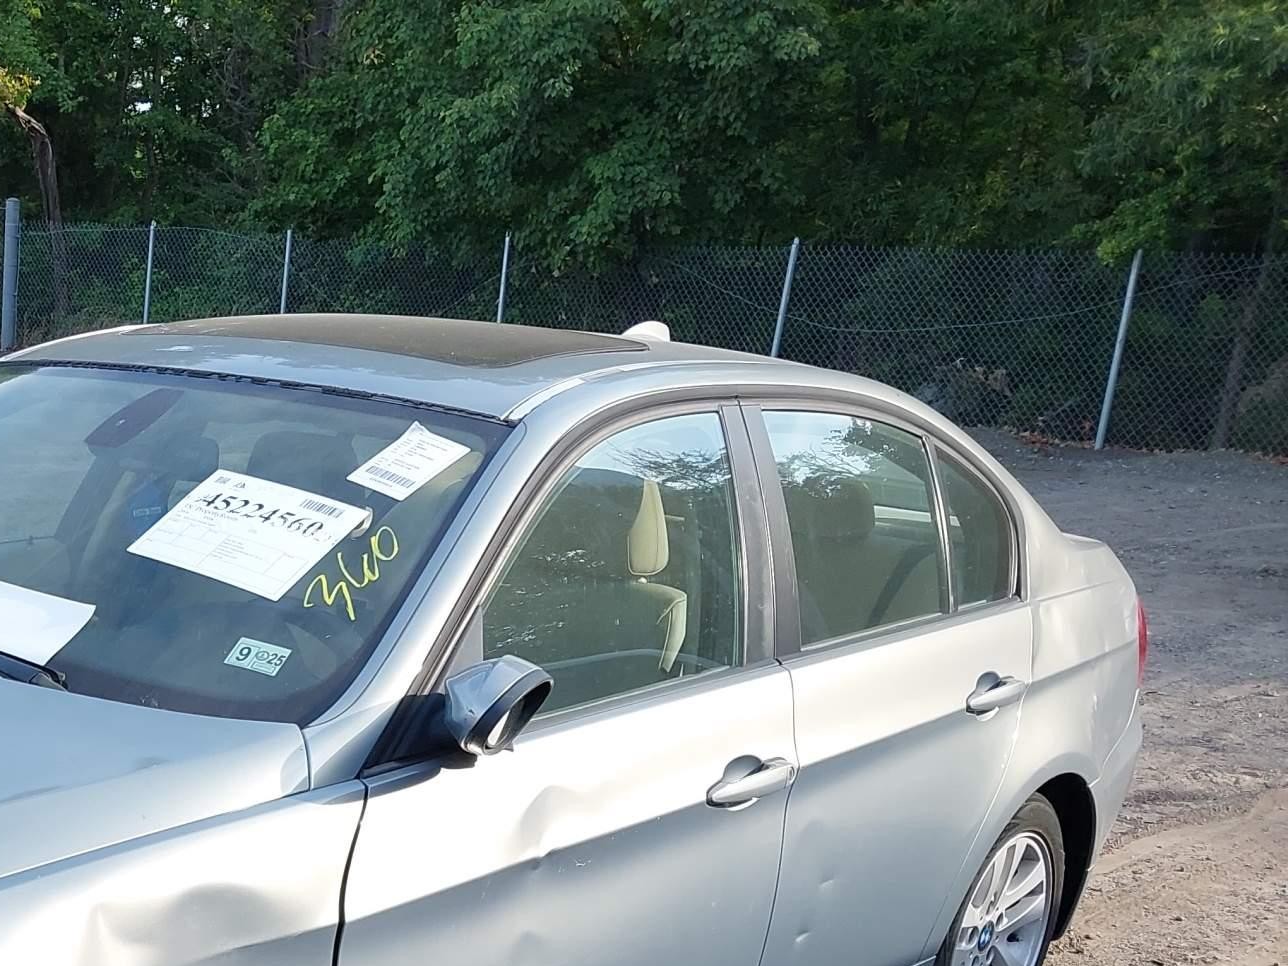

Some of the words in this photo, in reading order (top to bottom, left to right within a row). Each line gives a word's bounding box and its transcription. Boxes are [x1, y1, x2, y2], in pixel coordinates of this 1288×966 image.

[196, 493, 324, 537] 45224560
[303, 526, 399, 621] 360
[235, 646, 252, 661] 9
[266, 653, 287, 666] 25
